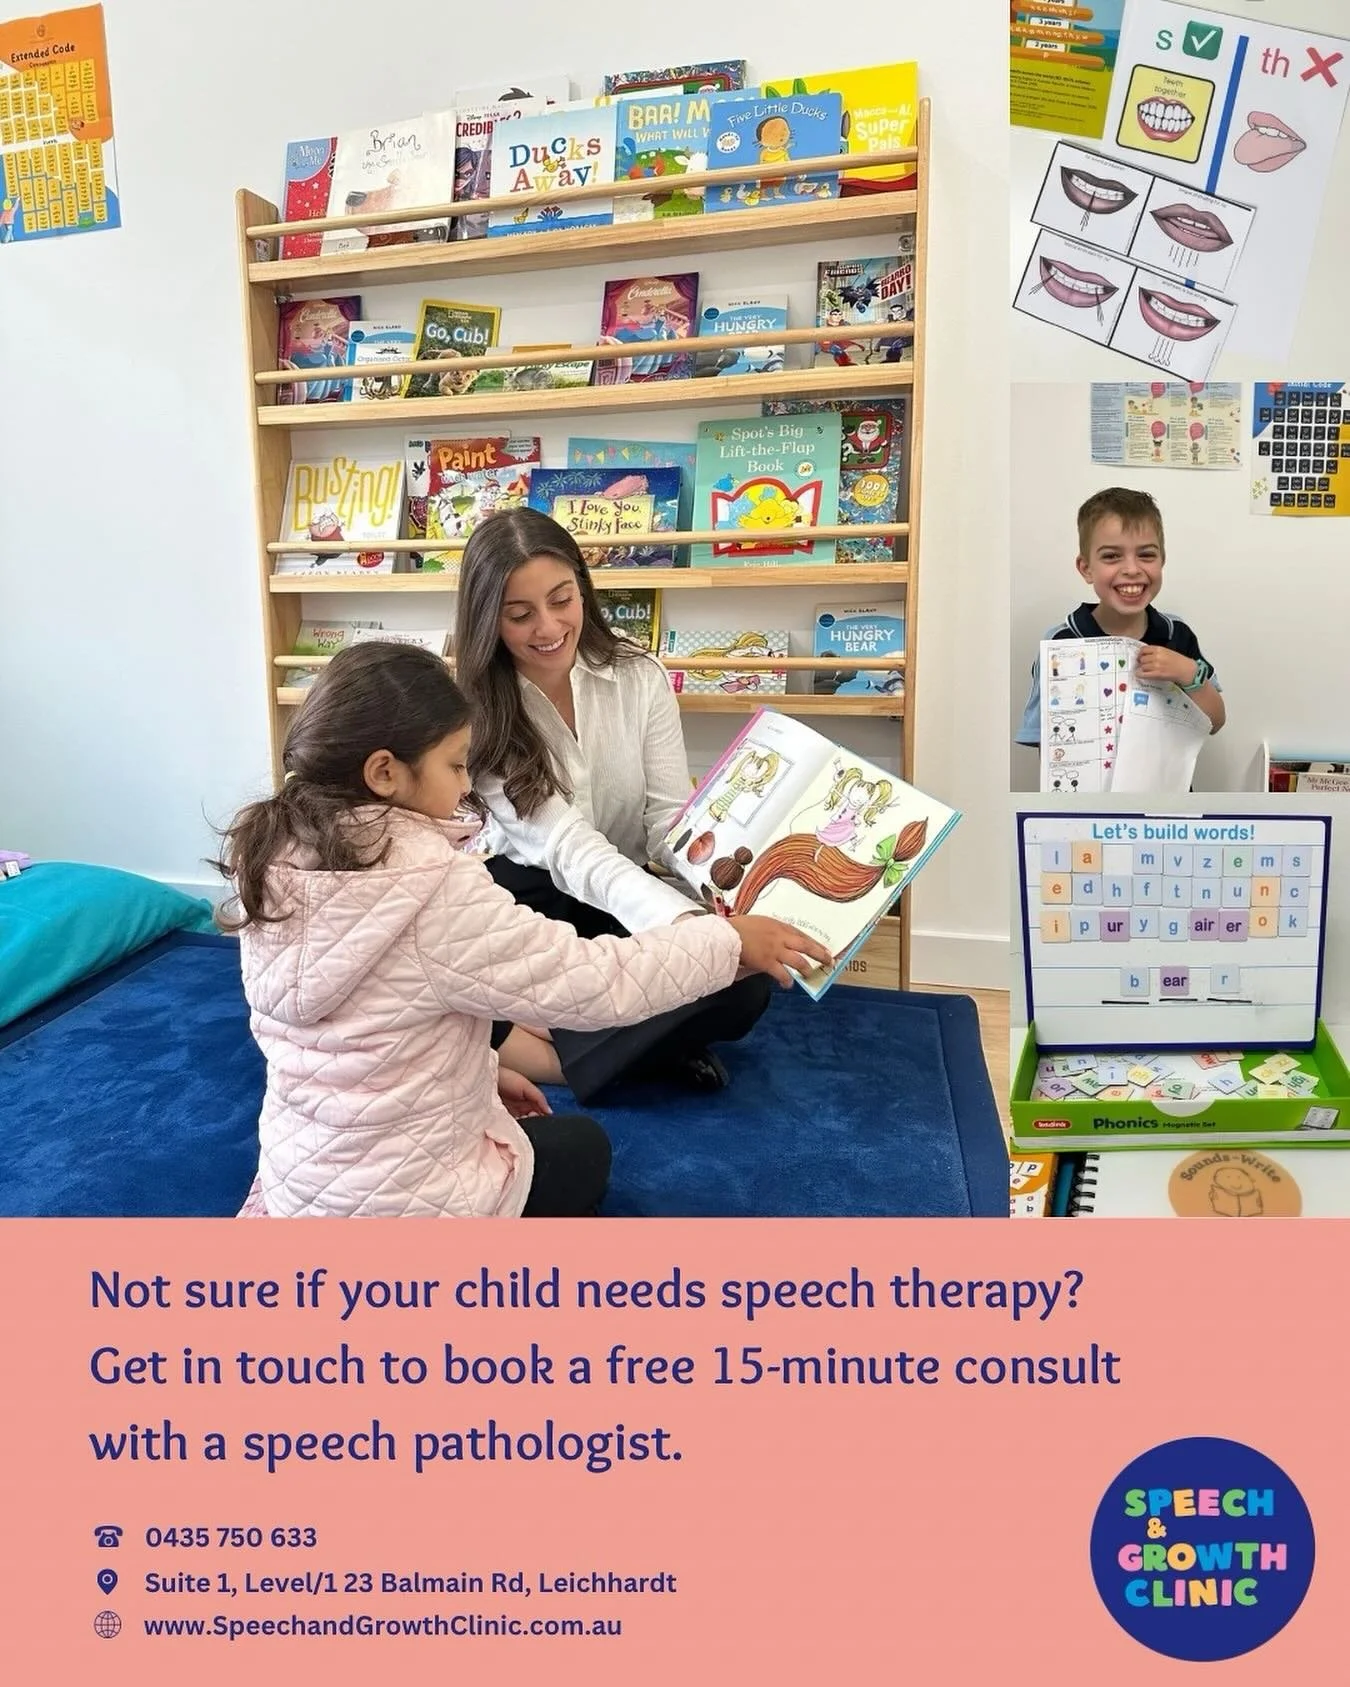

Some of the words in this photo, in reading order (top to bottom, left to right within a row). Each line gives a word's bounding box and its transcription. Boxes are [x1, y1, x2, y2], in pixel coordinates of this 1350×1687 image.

[1156, 30, 1173, 50] s
[11, 47, 49, 63] Extended
[52, 43, 75, 55] Code
[1262, 48, 1290, 78] th
[1163, 76, 1184, 88] Teeth
[1154, 85, 1186, 99] together
[628, 104, 680, 130] BAA!
[728, 111, 752, 128] Five
[754, 102, 788, 117] Little
[791, 102, 828, 120] Ducks
[635, 130, 668, 143] WHAT
[672, 128, 698, 139] WILL
[856, 117, 909, 141] Super
[366, 130, 421, 156] Brian
[509, 136, 601, 168] Ducks
[869, 135, 901, 152] Pals
[510, 161, 598, 193] Away!
[881, 264, 912, 287] BIZARRO
[881, 274, 911, 301] DAY!
[426, 323, 450, 343] Go,
[454, 327, 489, 346] Cub!
[714, 318, 777, 333] HUNGRY
[731, 425, 775, 442] Spot's
[778, 424, 804, 439] Big
[438, 443, 497, 471] Paint
[720, 442, 815, 459] Lift-the-Flap
[747, 459, 784, 473] Book
[581, 500, 608, 516] Love
[566, 517, 612, 535] Stinky
[615, 517, 642, 534] Face
[616, 605, 651, 619] Cub!
[313, 628, 345, 643] Wrong
[318, 639, 339, 649] Way
[830, 629, 895, 641] HUNGRY
[845, 641, 877, 652] BEAR
[1093, 823, 1138, 840] Let's
[1144, 823, 1188, 840] build
[1194, 824, 1255, 841] words!
[1083, 853, 1092, 864] a
[1141, 853, 1155, 865] m
[1173, 856, 1182, 867] v
[1203, 857, 1211, 868] z
[1233, 856, 1243, 867] e
[1261, 856, 1274, 867] m
[1292, 856, 1300, 867] s
[1052, 883, 1061, 894] e
[1083, 880, 1093, 893] d
[1113, 883, 1121, 897] h
[1144, 882, 1150, 896] f
[1174, 886, 1180, 899] t
[1202, 888, 1210, 899] n
[1233, 886, 1242, 897] u
[1261, 885, 1269, 896] n
[1290, 887, 1299, 898] c
[1054, 920, 1059, 933] i
[1080, 920, 1089, 935] p
[1107, 919, 1123, 932] ur
[1139, 918, 1148, 933] y
[1169, 921, 1178, 935] g
[1194, 918, 1215, 932] air
[1226, 921, 1242, 933] er
[1258, 916, 1267, 927] o
[1288, 915, 1296, 928] k
[1130, 973, 1140, 987] b
[1163, 975, 1187, 987] ear
[1221, 974, 1228, 985] r
[1093, 1117, 1159, 1130] Phonics
[1180, 1152, 1282, 1183] Sounds-Write
